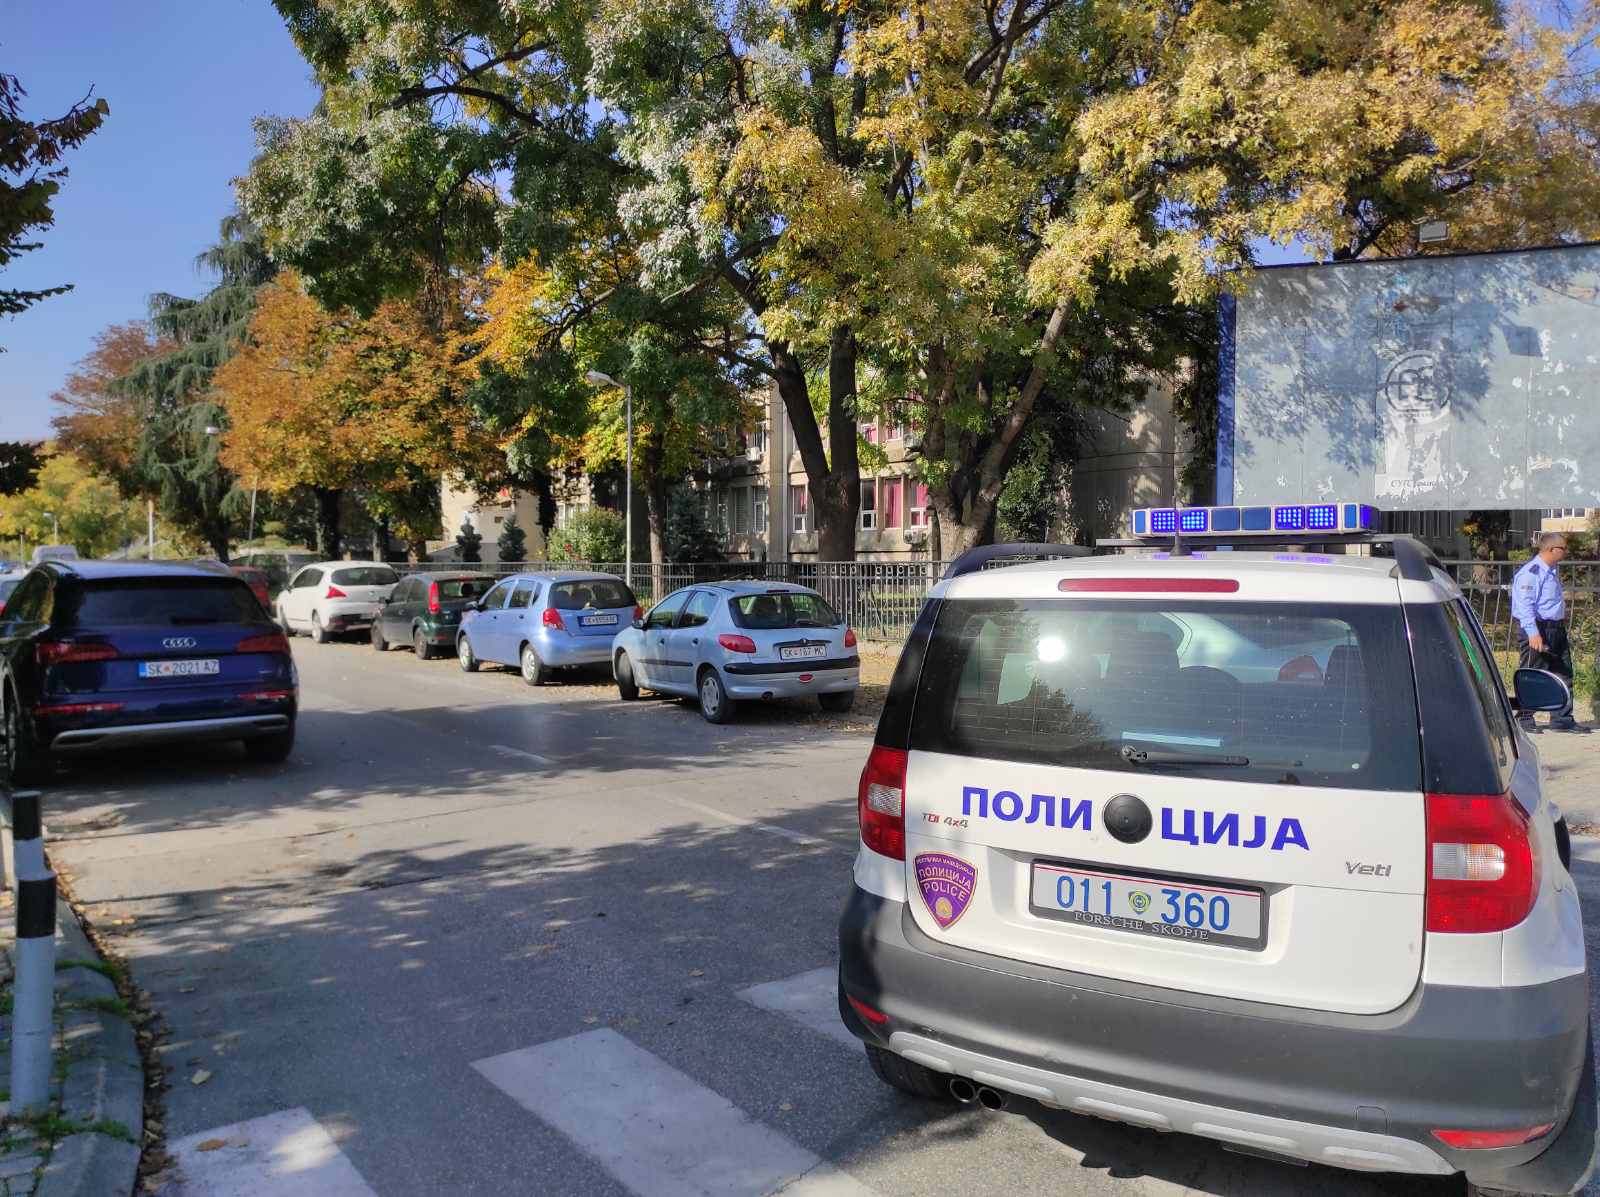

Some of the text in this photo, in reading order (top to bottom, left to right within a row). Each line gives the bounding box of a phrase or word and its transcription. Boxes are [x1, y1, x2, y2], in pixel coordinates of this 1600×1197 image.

[148, 664, 162, 676] SK
[172, 662, 200, 675] 2021
[922, 812, 940, 824] TDI
[962, 786, 1310, 851] ПОЛИ ЦИЈА
[918, 867, 972, 890] ПОЛИЦИЈА
[923, 882, 967, 901] POLICE
[1056, 875, 1230, 932] 011 360
[1074, 911, 1209, 940] PORSCHE SKOPJE
